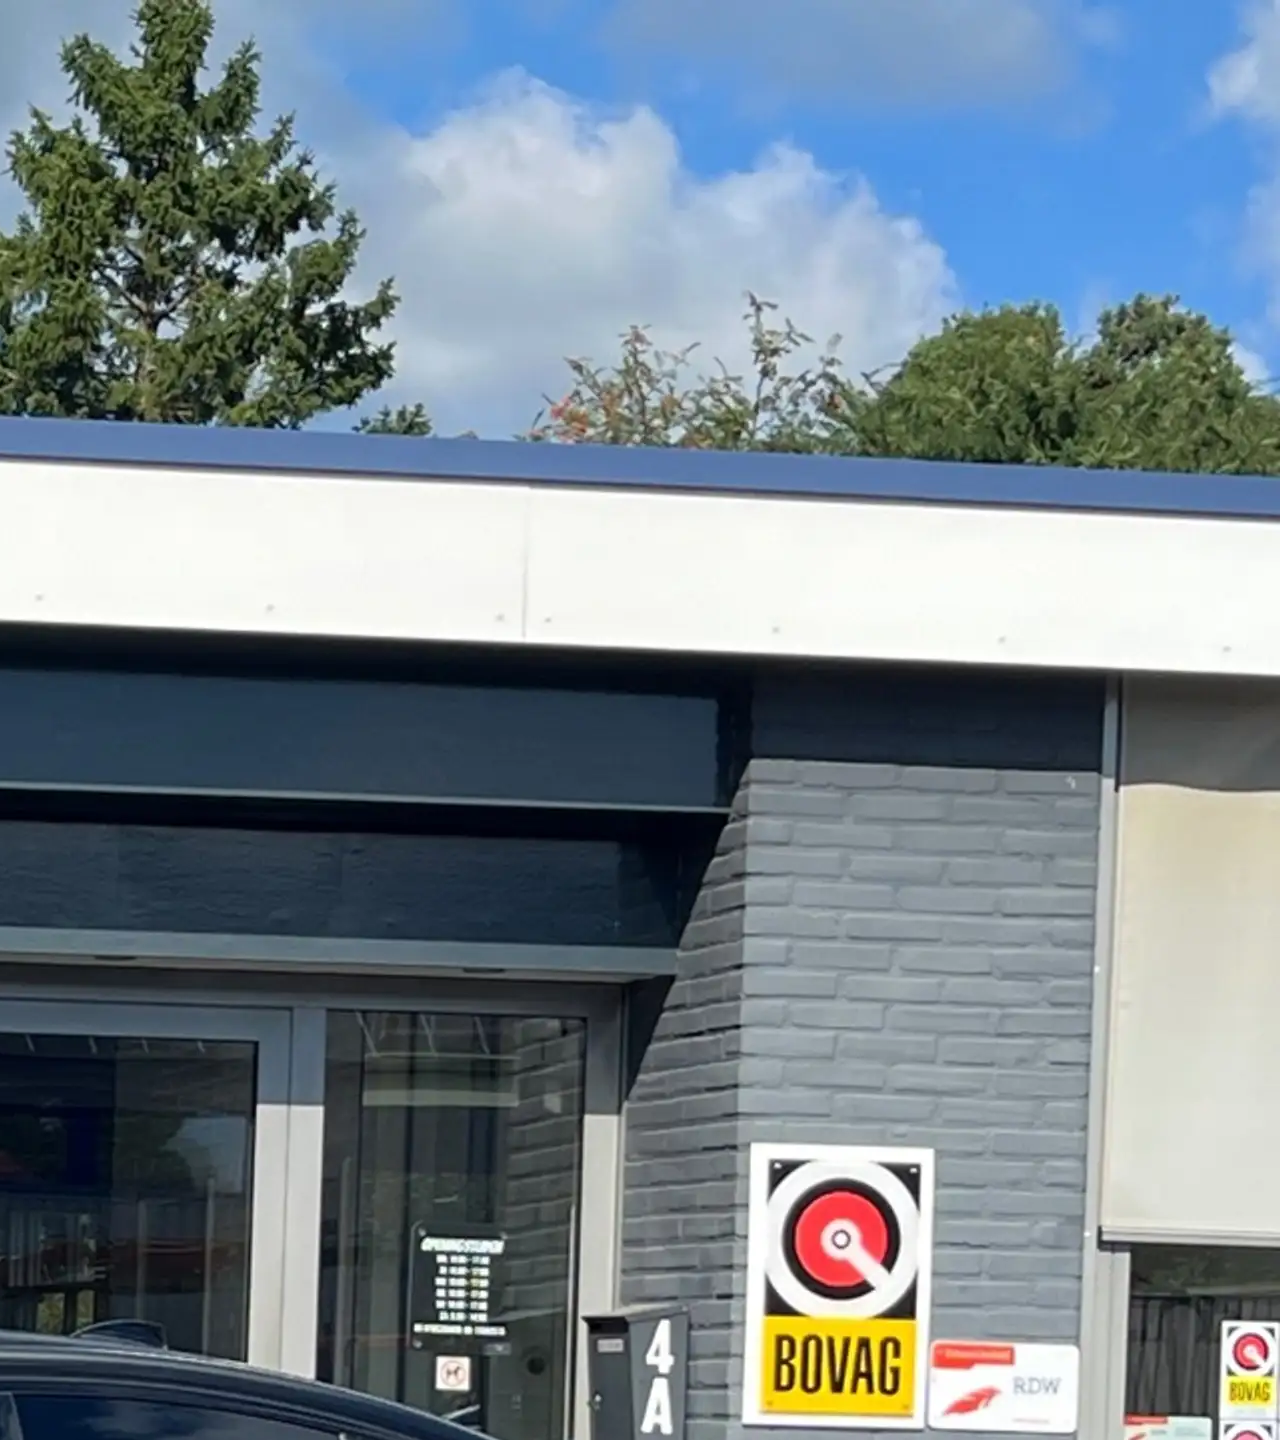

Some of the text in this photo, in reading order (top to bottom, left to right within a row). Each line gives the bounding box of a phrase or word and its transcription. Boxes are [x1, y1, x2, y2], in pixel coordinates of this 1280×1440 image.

[645, 1318, 676, 1375] 4
[773, 1333, 902, 1396] BOVAG
[1012, 1376, 1062, 1395] RDW
[1228, 1381, 1271, 1402] BOVAG
